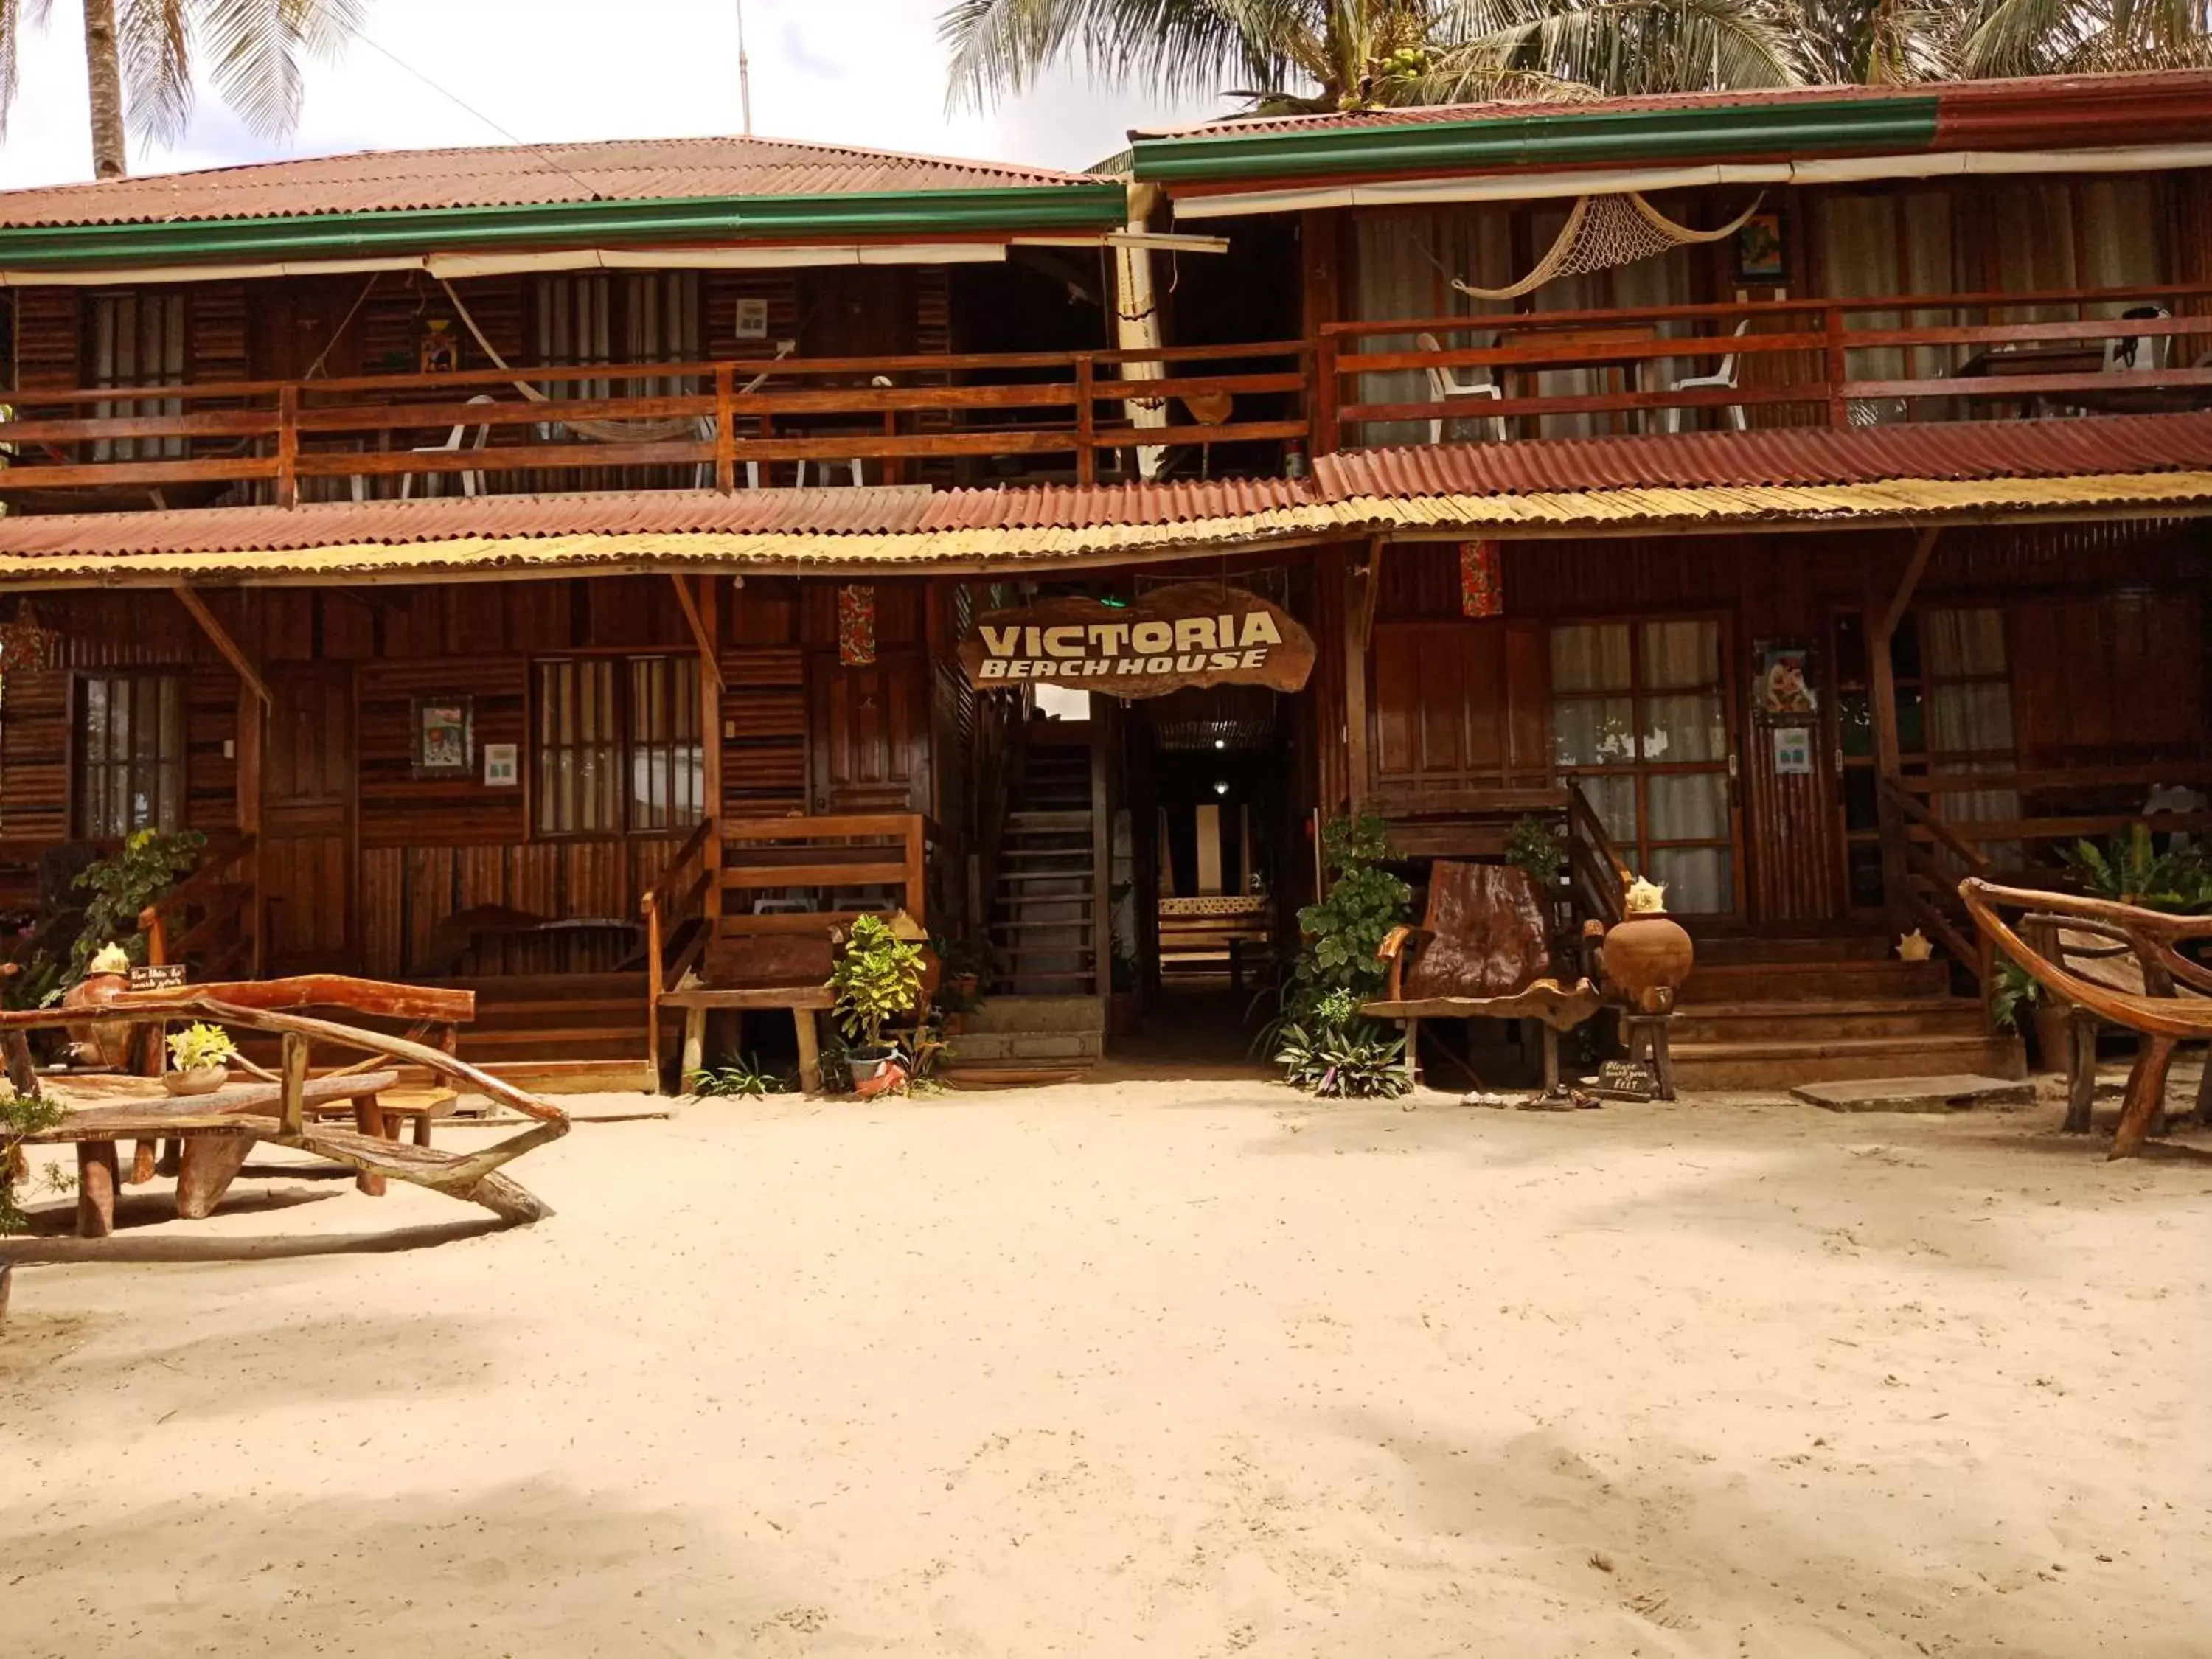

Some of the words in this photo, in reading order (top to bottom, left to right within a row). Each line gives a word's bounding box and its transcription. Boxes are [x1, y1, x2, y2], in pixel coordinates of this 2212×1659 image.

[978, 611, 1282, 657] VICTORIA
[978, 658, 1110, 678] BEACH
[1116, 648, 1268, 675] HOUSE
[1605, 1061, 1638, 1071] Please
